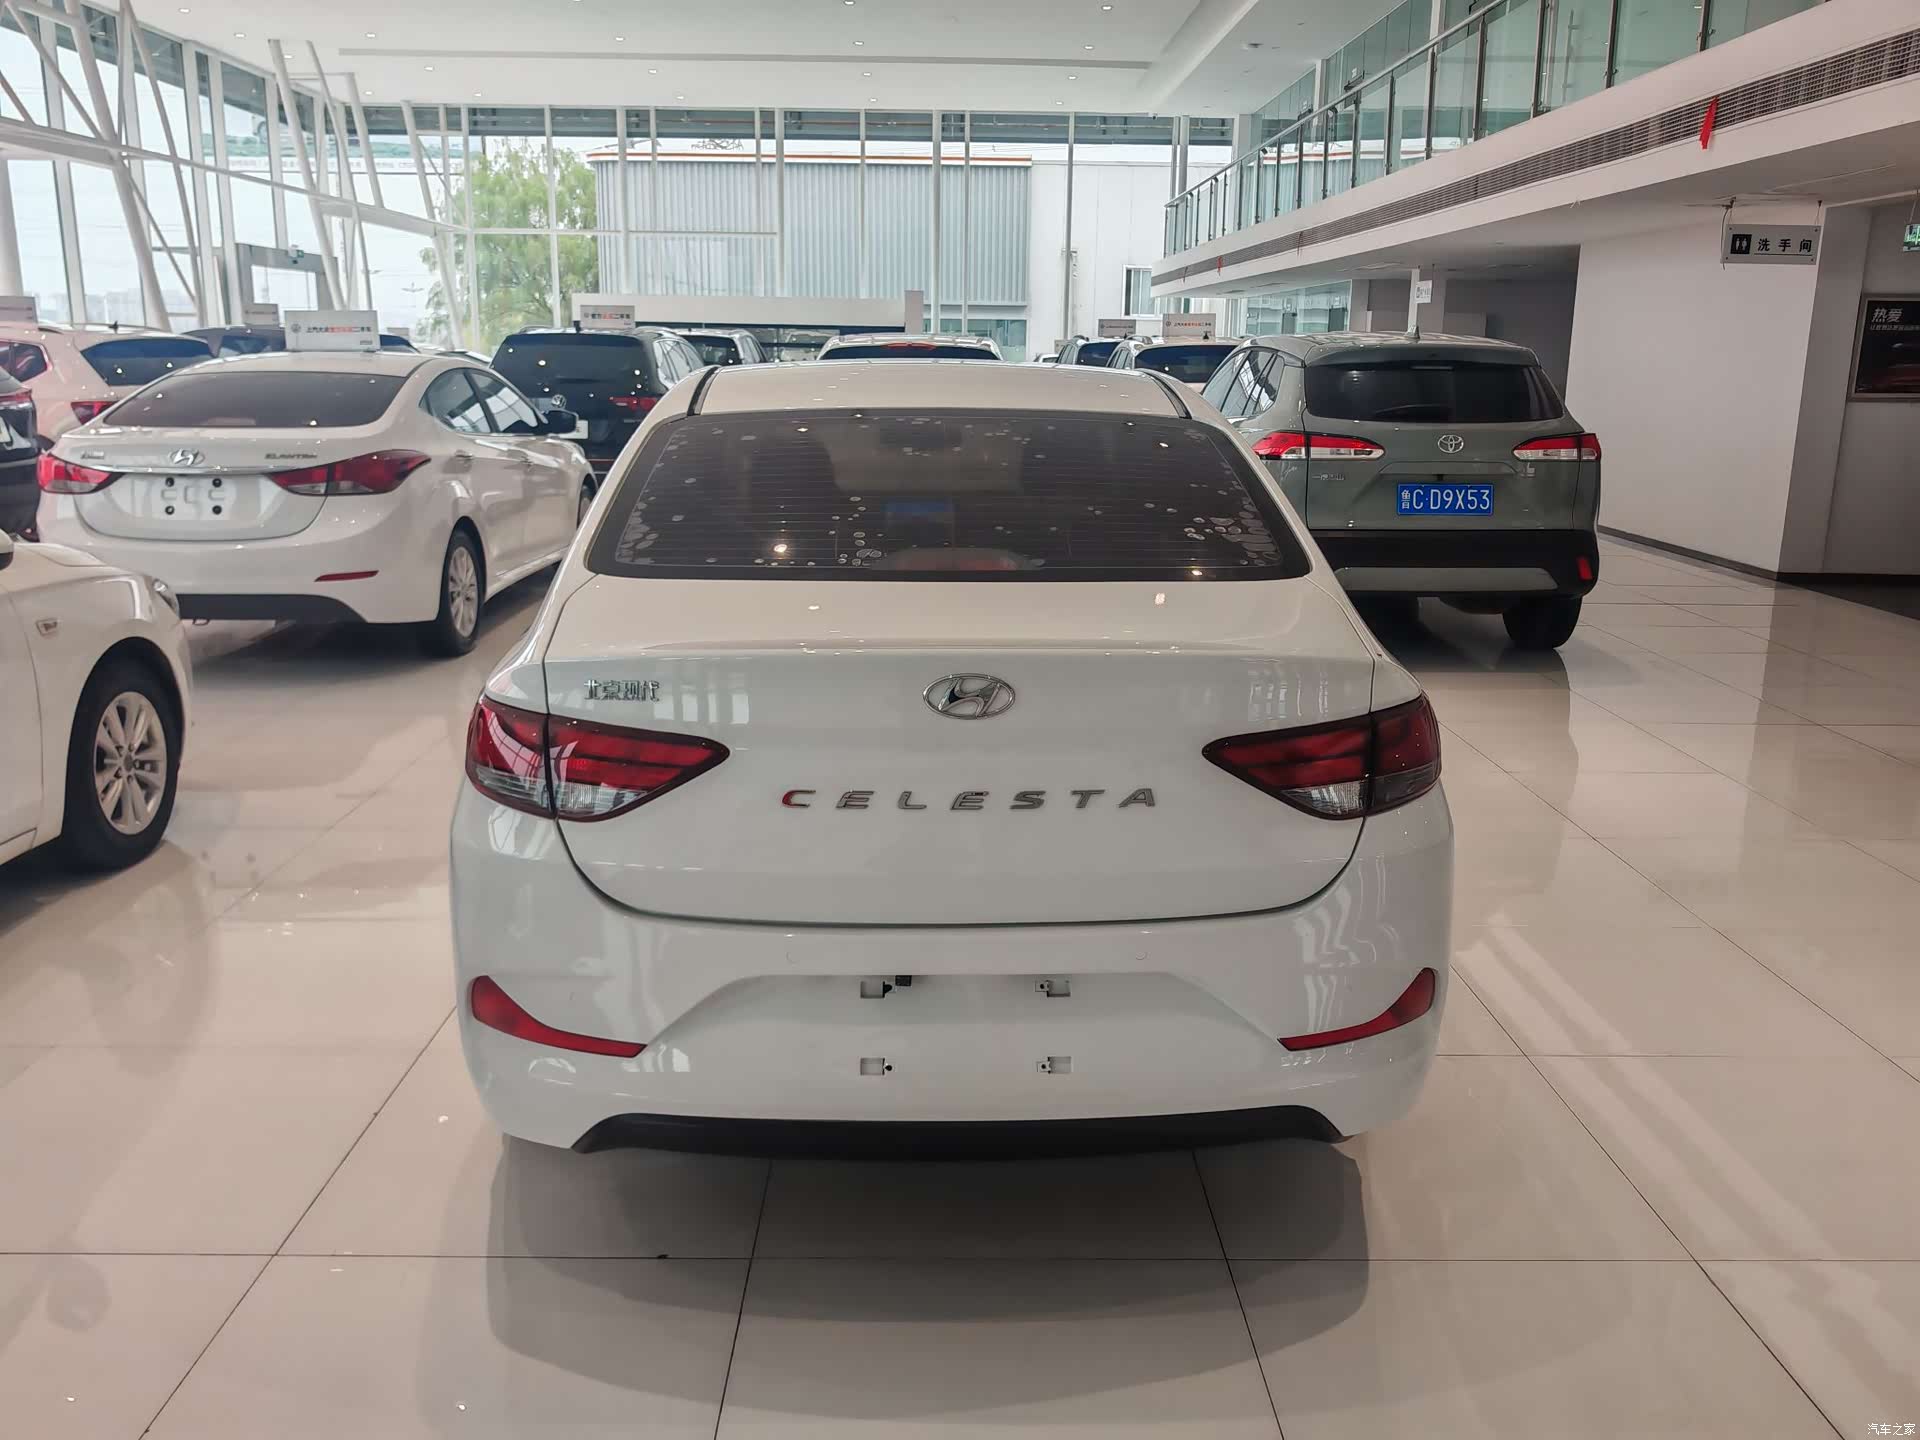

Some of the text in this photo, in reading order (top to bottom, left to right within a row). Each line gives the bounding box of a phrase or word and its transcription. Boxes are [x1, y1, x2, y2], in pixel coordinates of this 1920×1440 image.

[1758, 238, 1812, 252] 洗手间
[1872, 308, 1902, 322] 热爱
[584, 680, 660, 701] 北京现代
[782, 788, 1157, 811] CELESTA
